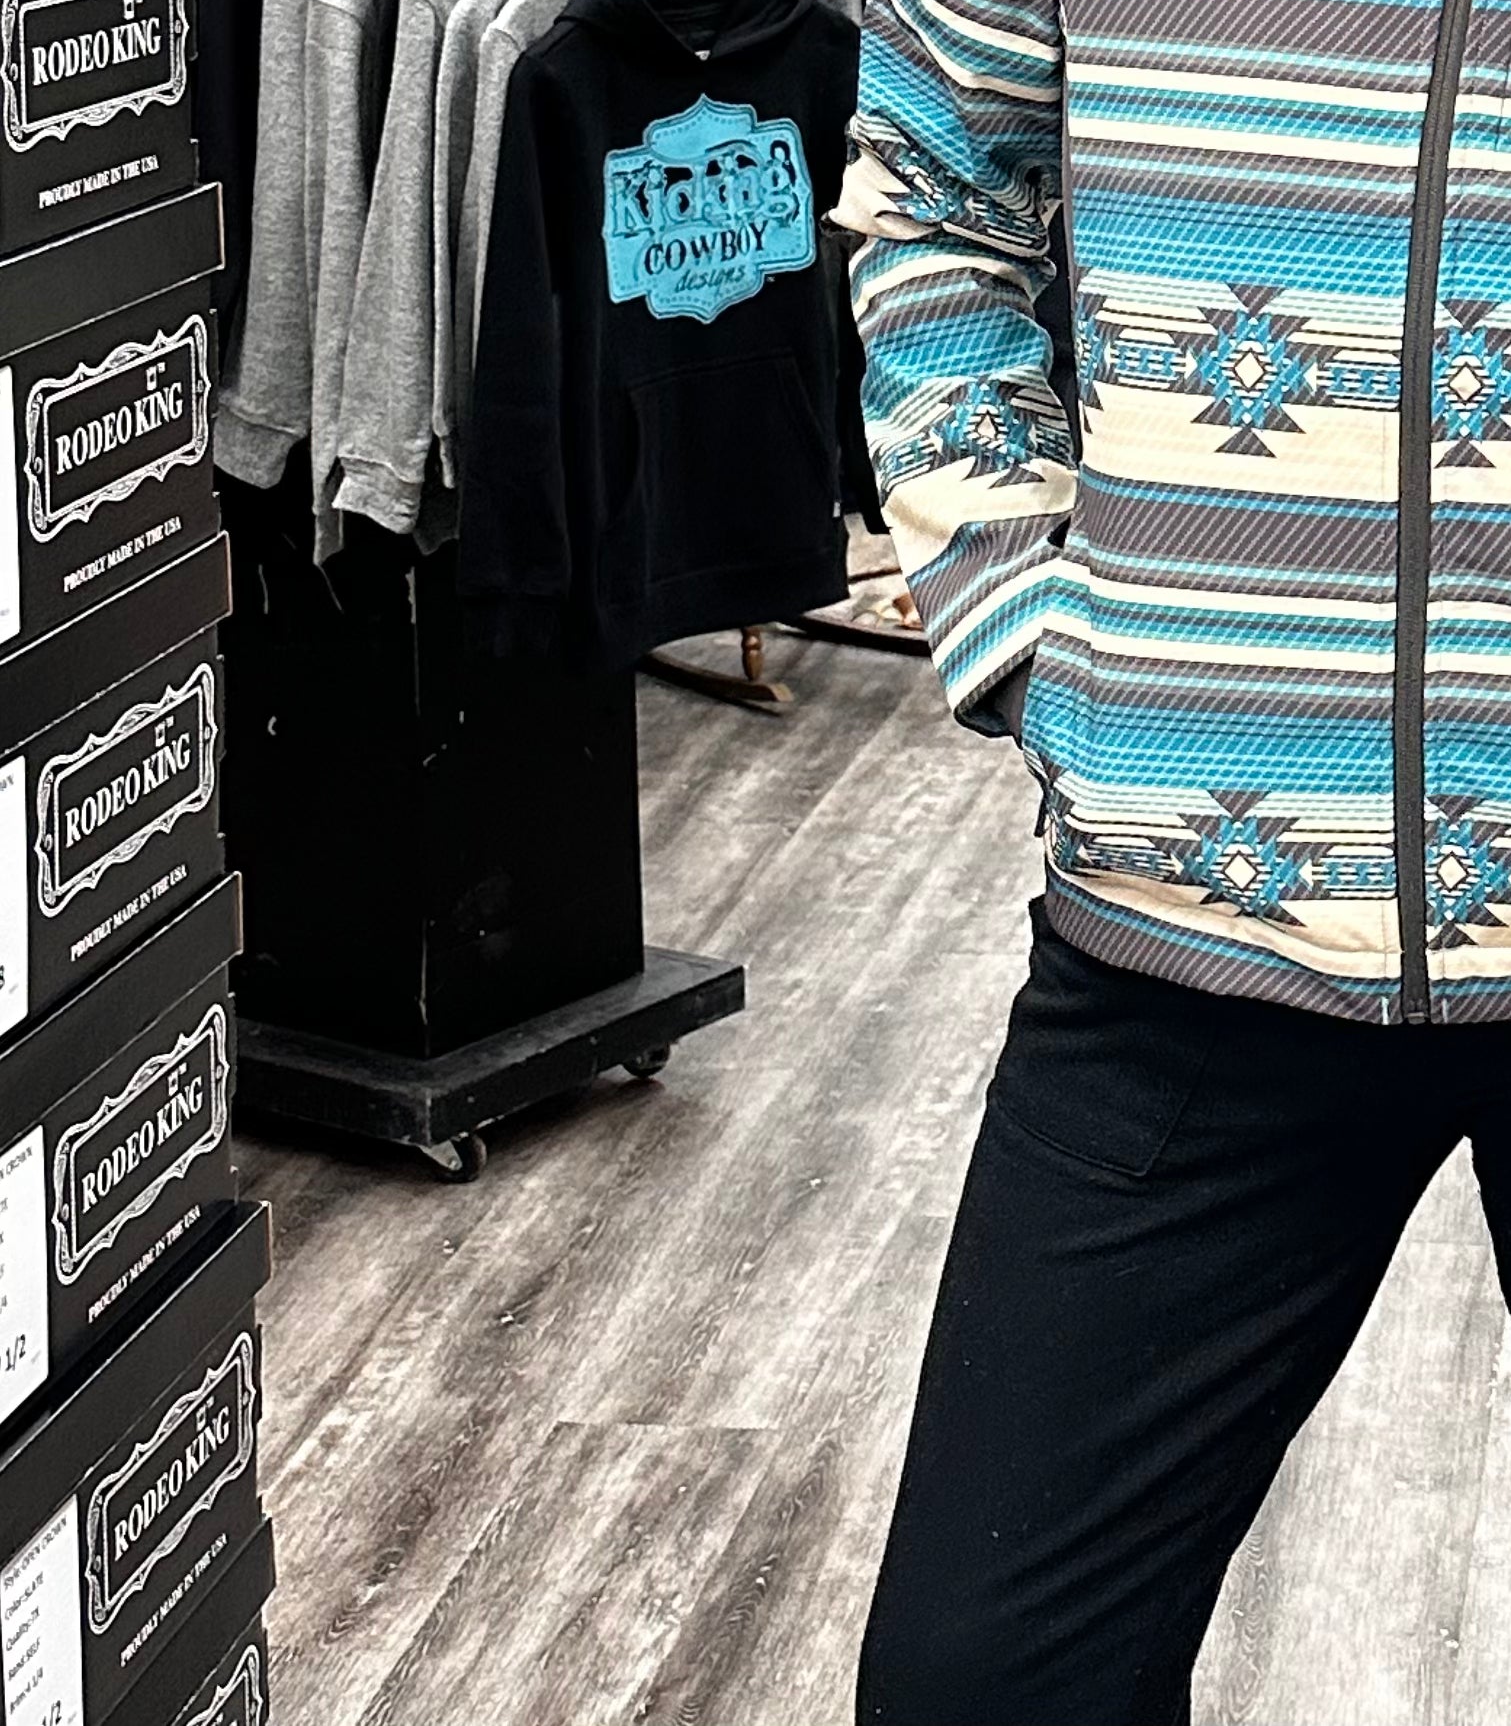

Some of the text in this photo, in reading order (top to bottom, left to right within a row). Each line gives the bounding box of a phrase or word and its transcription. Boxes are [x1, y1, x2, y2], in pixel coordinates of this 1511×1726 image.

[31, 17, 162, 86] RODEO KING
[38, 154, 160, 209] PROUDLY MADE IN THE USA
[611, 140, 799, 238] Kicking
[644, 220, 769, 276] COWBOY
[55, 382, 183, 475] RODEO KING
[63, 516, 182, 593] PROUDLY MADE IN THE USA
[65, 732, 191, 849] RODEO KING
[70, 864, 188, 962] PROUDLY MADE IN THE USA
[82, 1074, 204, 1215] RODEO KING
[88, 1203, 202, 1324] PROUDLY MADE IN THE USA
[5, 1334, 27, 1373] 1/2
[114, 1405, 231, 1562] RODEO KING
[120, 1532, 230, 1668] PROUDLY MADE IN THE USA
